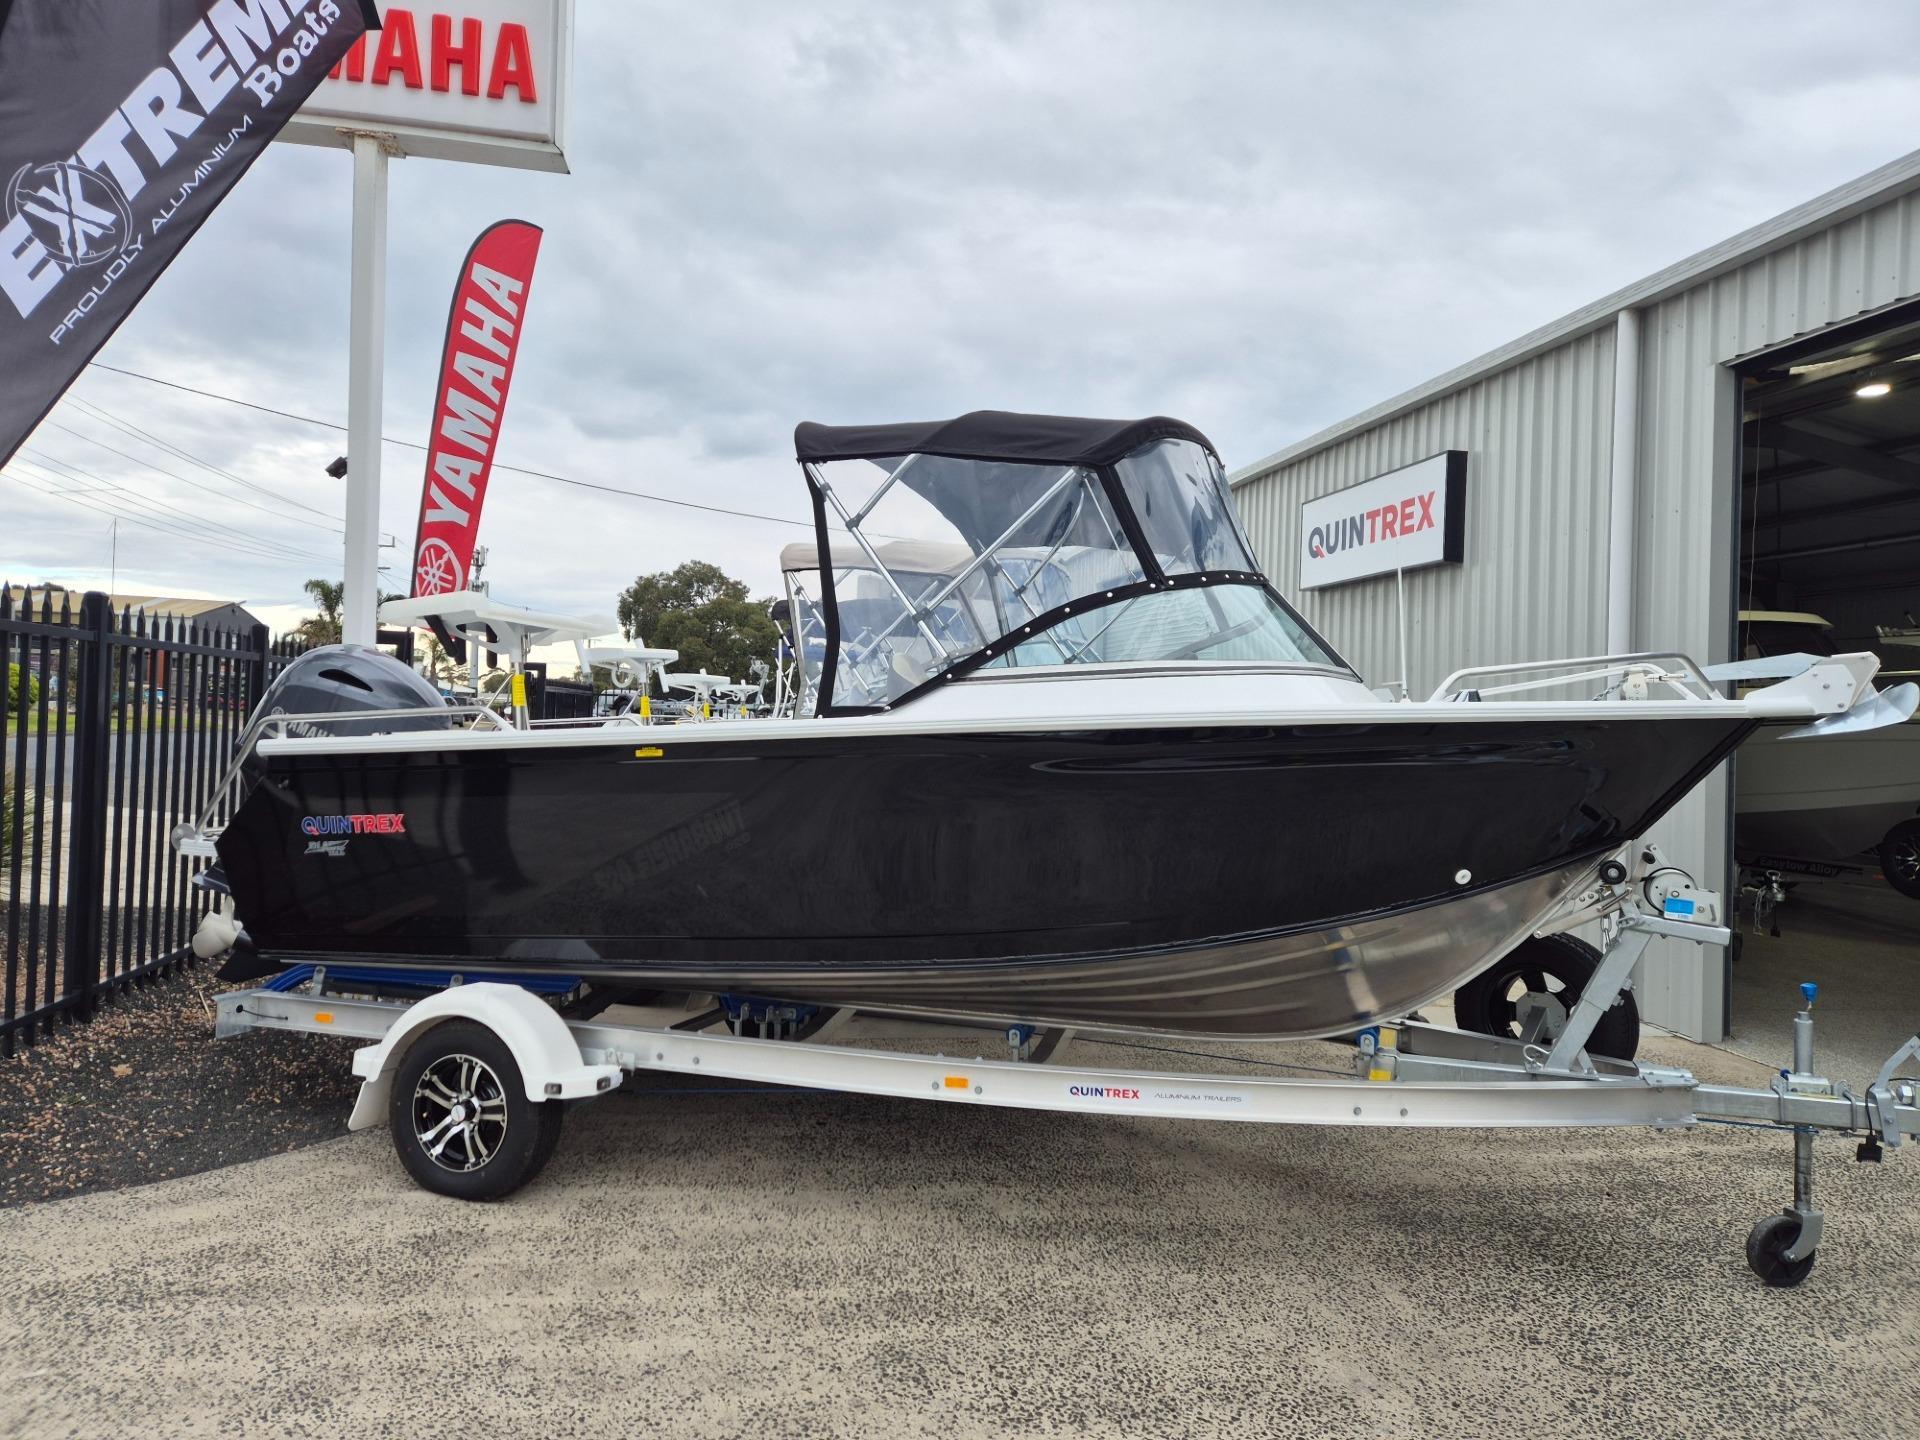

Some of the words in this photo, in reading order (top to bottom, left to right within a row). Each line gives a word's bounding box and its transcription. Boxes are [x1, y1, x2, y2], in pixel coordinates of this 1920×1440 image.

[242, 0, 341, 108] Boats
[0, 0, 310, 319] EXTREM
[49, 233, 143, 345] PROUDLY
[151, 114, 253, 235] ALUMINIUM
[424, 261, 524, 528] YAMAHA
[1308, 490, 1436, 559] QUINTREX
[301, 813, 406, 836] QUINTREX
[1809, 863, 1840, 875] Alloy
[1069, 1086, 1140, 1100] QUINTREX
[1154, 1092, 1201, 1101] ALUMINIUM
[1204, 1094, 1242, 1103] TRAILERS
